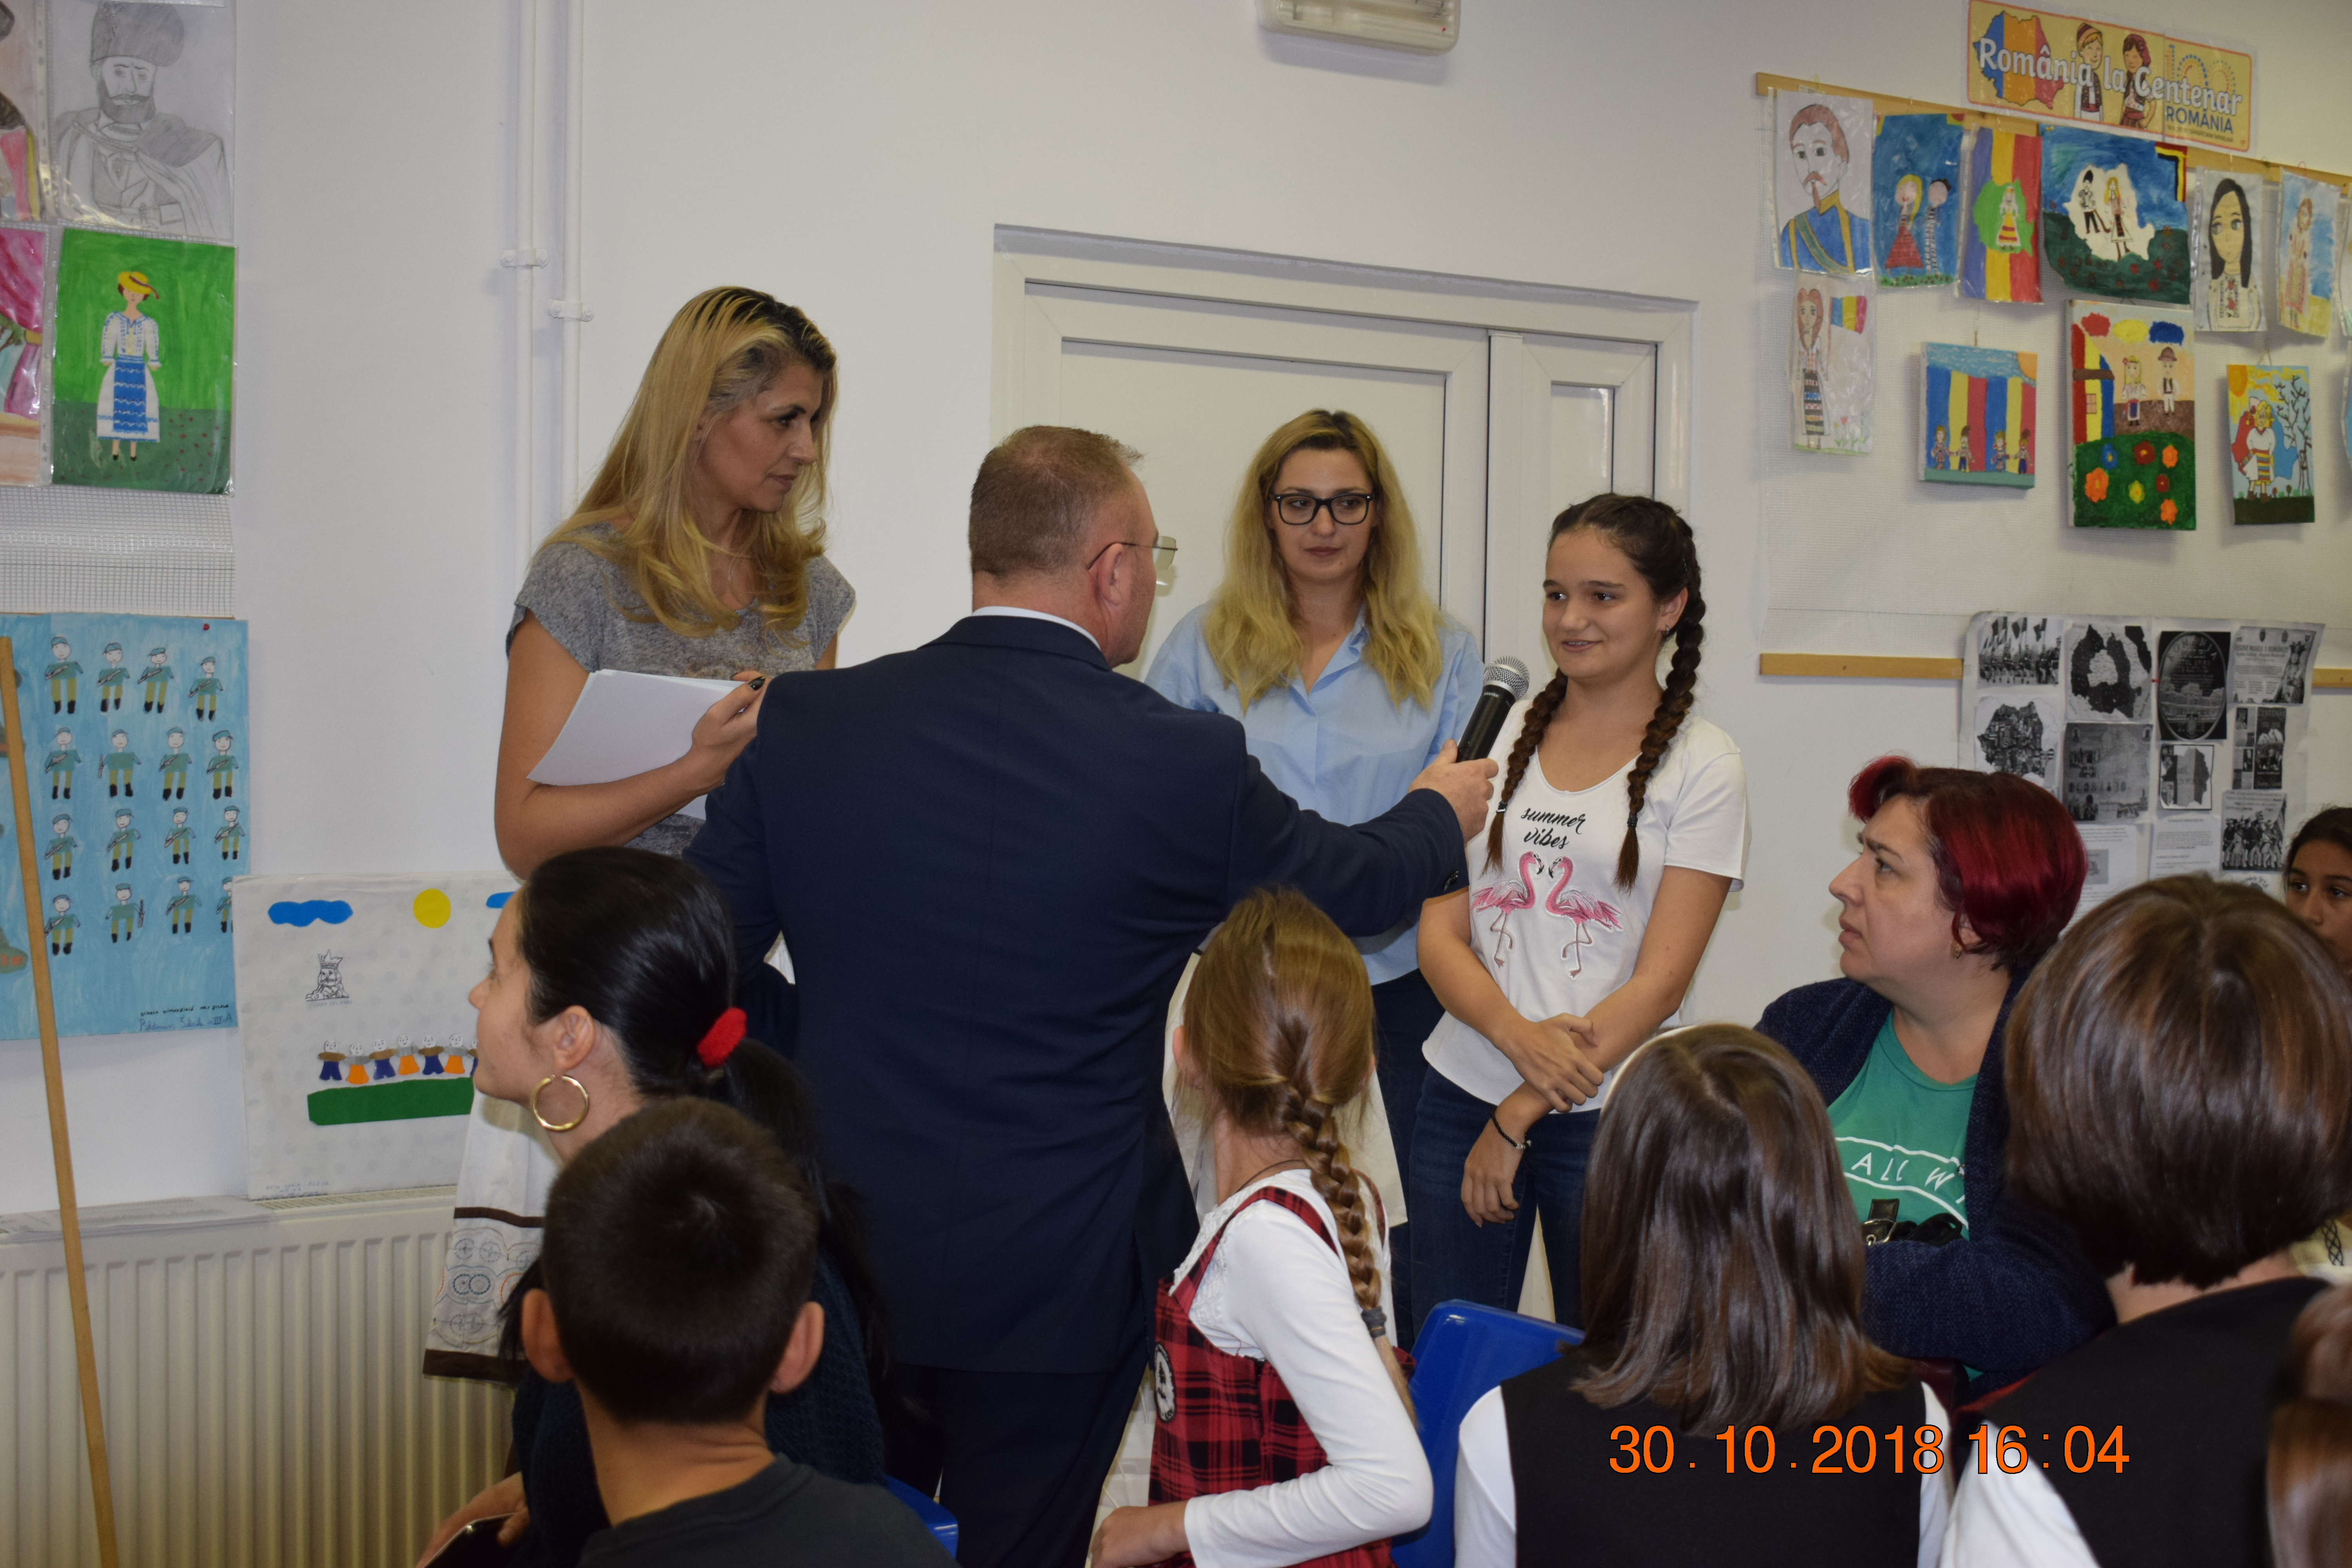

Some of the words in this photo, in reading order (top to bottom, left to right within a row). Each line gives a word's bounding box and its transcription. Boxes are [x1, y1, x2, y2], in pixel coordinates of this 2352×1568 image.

[1979, 37, 2093, 87] România
[2103, 55, 2126, 93] la
[2134, 66, 2243, 116] Centenar
[1520, 808, 1586, 834] summer
[1524, 828, 1570, 849] vibes
[1851, 1152, 1909, 1181] ALL
